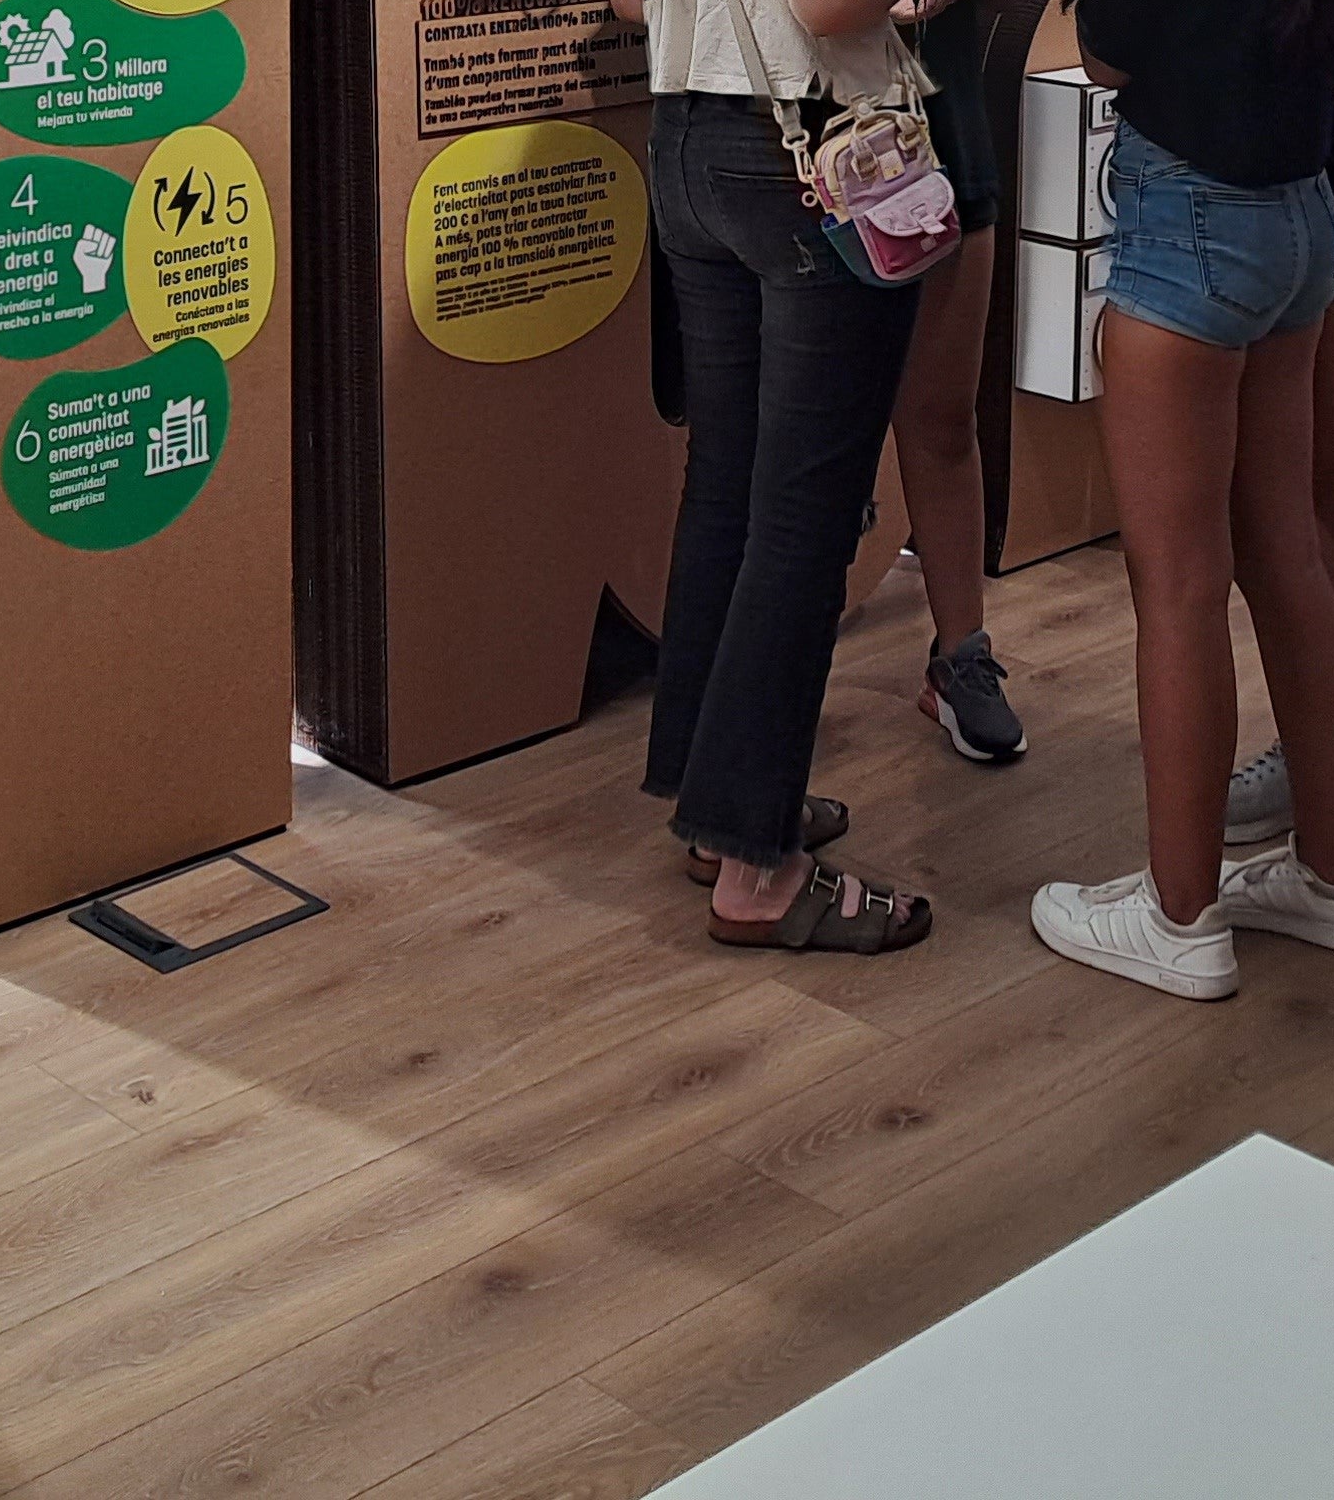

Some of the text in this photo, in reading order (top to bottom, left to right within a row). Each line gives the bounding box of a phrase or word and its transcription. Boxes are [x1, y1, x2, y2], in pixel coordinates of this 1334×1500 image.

[82, 38, 167, 82] 3 Millora
[37, 80, 163, 109] el teu habitatge
[11, 173, 39, 216] 4
[225, 184, 248, 225] 5
[4, 251, 40, 271] dret
[44, 250, 54, 265] a
[153, 236, 248, 267] Connecta't a
[158, 258, 249, 288] les energies
[167, 278, 249, 307] renovables
[47, 384, 151, 419] Suma't a una
[15, 420, 40, 463] 6
[48, 410, 130, 442] comunitat
[49, 431, 134, 464] energètica
